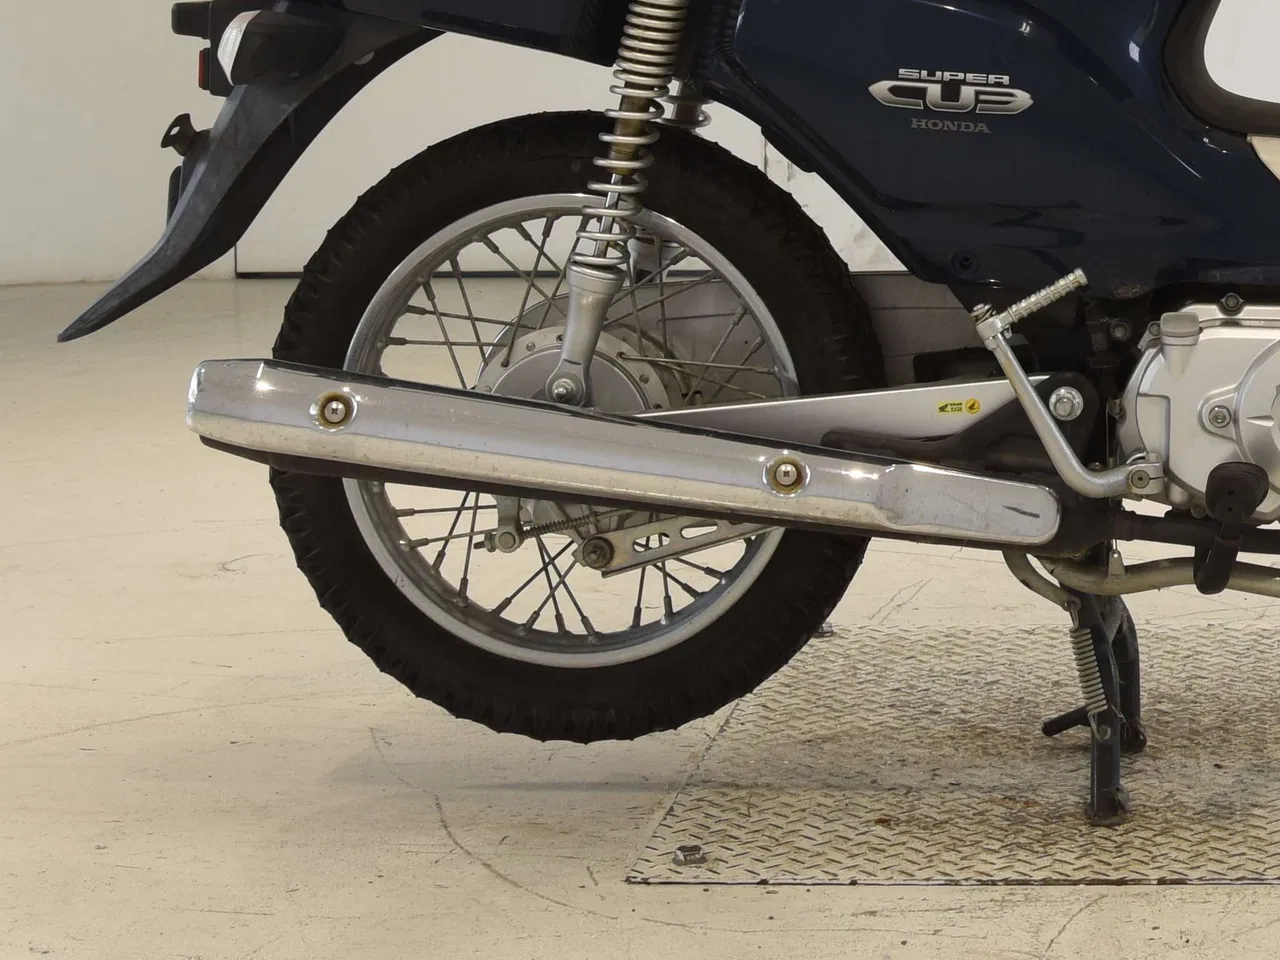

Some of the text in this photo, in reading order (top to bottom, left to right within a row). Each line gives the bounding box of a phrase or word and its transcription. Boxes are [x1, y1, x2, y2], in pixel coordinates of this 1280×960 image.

[898, 68, 1010, 85] SUPER
[868, 80, 1034, 115] CUB
[911, 117, 992, 134] HONDA
